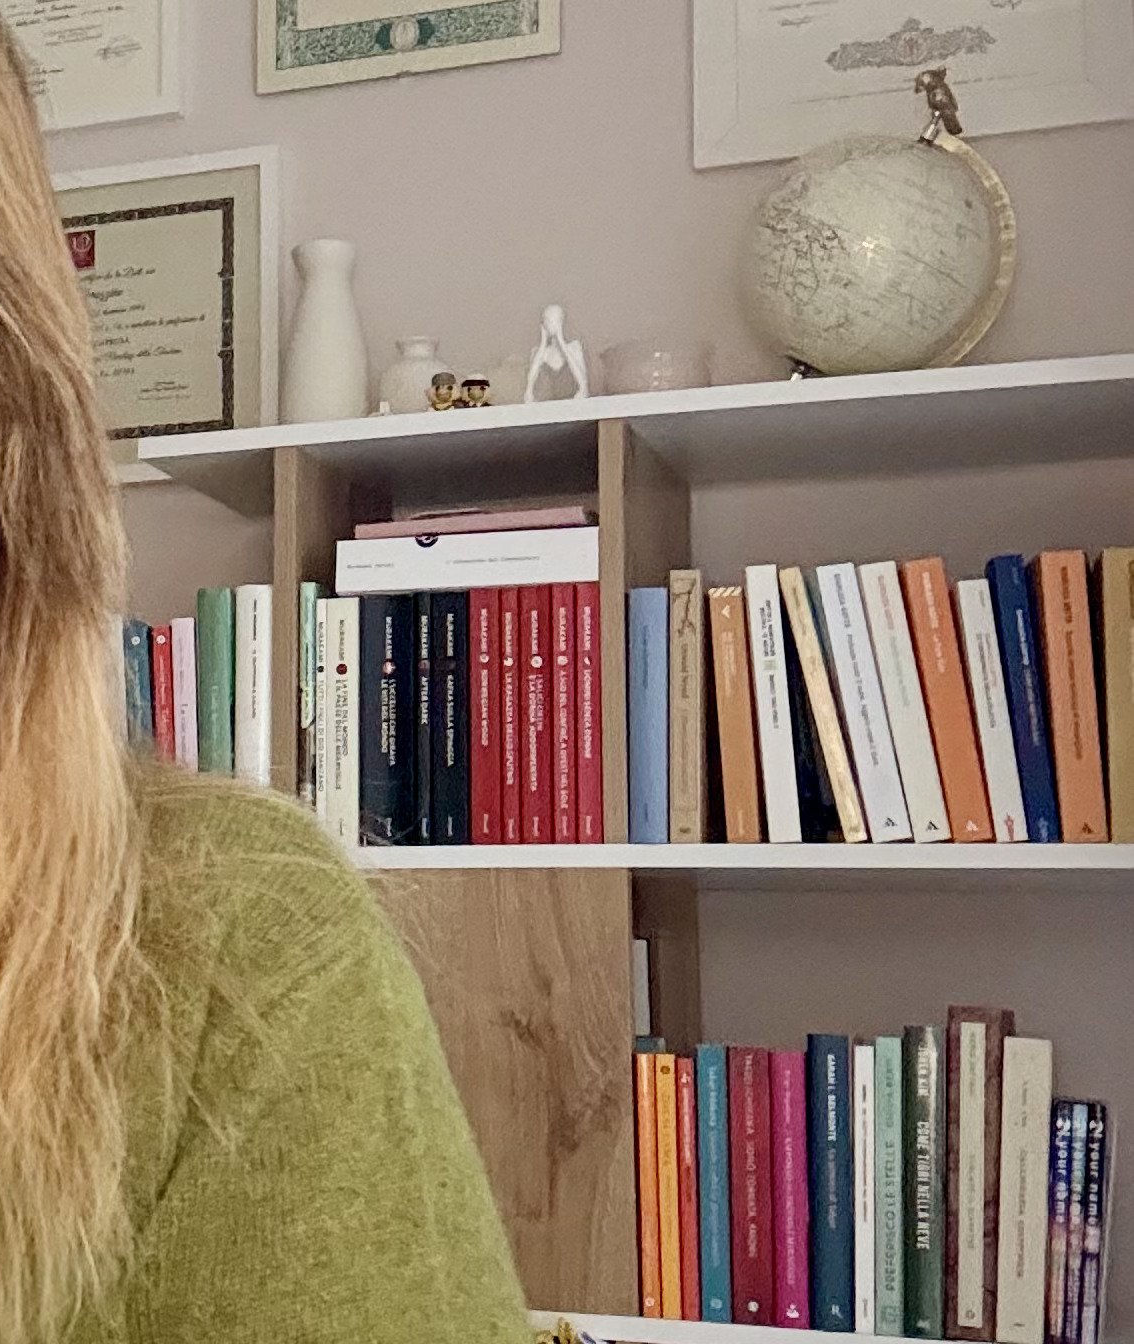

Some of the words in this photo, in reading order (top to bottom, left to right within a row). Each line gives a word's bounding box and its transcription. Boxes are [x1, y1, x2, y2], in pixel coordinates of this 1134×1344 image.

[917, 1121, 931, 1150] COME
[917, 1184, 930, 1219] NELLA
[917, 1221, 930, 1249] NEVE
